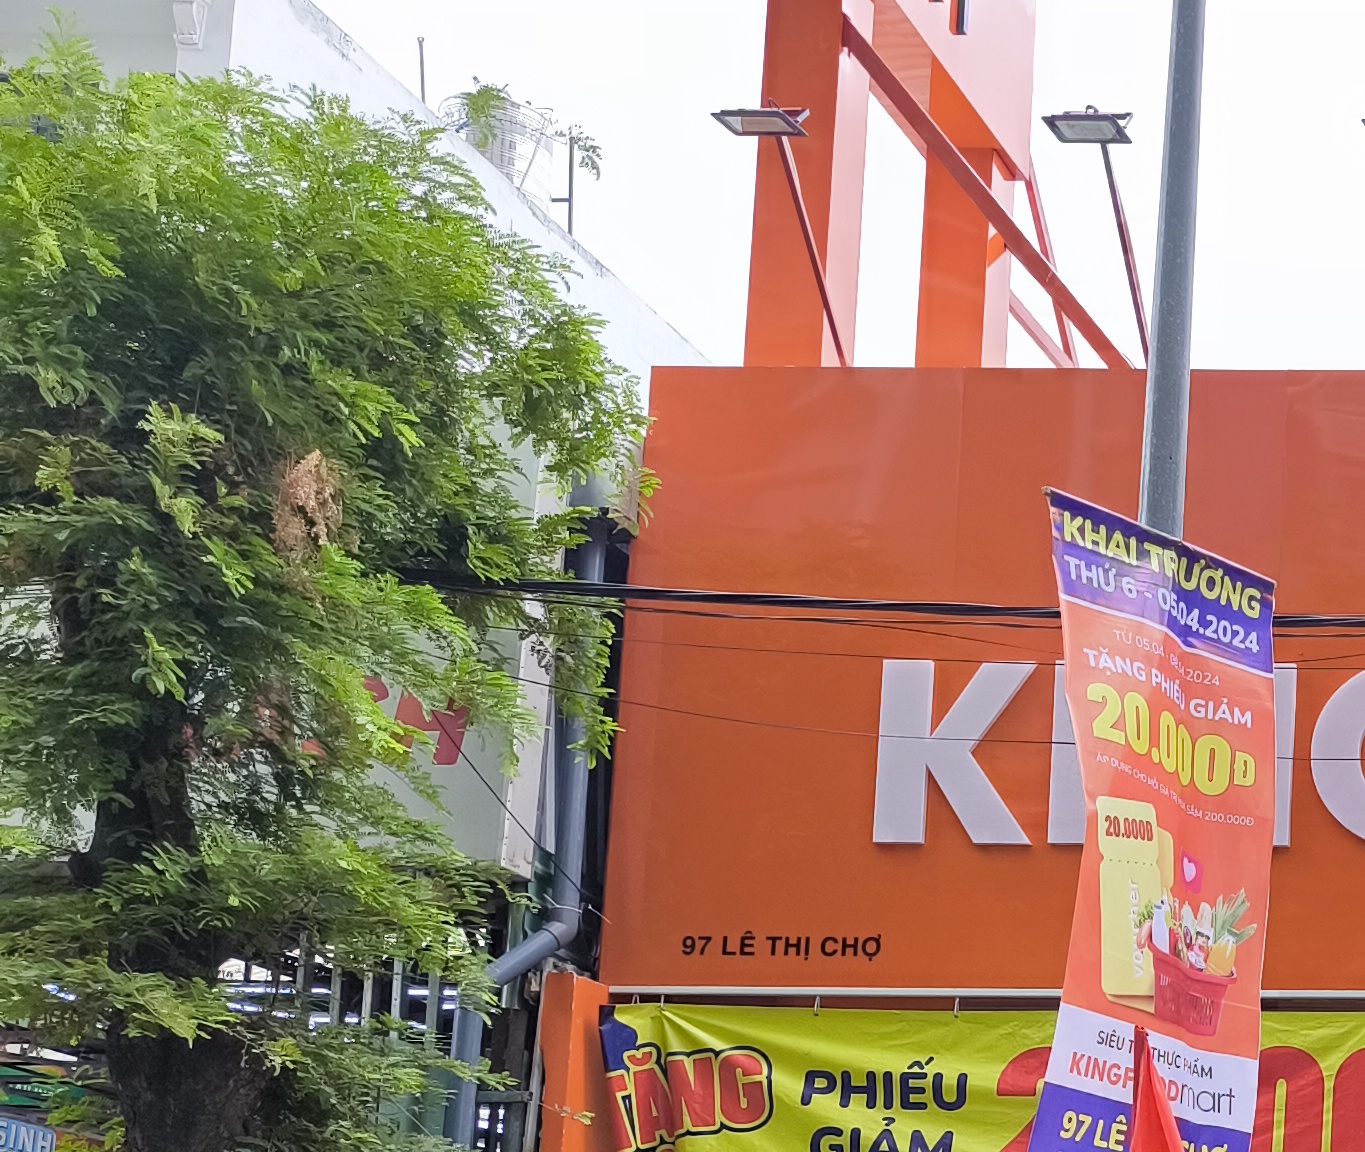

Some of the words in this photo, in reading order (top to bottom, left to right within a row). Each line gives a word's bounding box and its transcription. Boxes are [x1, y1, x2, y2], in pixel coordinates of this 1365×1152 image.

[1062, 511, 1138, 567] KHAI
[1145, 541, 1262, 619] TRƯƠNG
[1063, 554, 1118, 593] THỨ
[1121, 577, 1139, 600] 6
[1083, 647, 1147, 681] TẶNG
[1189, 697, 1252, 729] GIẢM
[681, 935, 713, 957] 97
[720, 930, 756, 957] LÊ
[767, 934, 812, 963] THỊ
[821, 933, 883, 962] CHỢ
[1096, 1029, 1126, 1051] SIÊU
[1150, 1046, 1182, 1070] THỰC
[1183, 1057, 1213, 1080] PHẨM
[800, 1056, 969, 1113] PHIẾU
[1068, 1051, 1236, 1116] KINGFDmart
[1059, 1110, 1092, 1143] 97
[1093, 1114, 1128, 1152] LÊ
